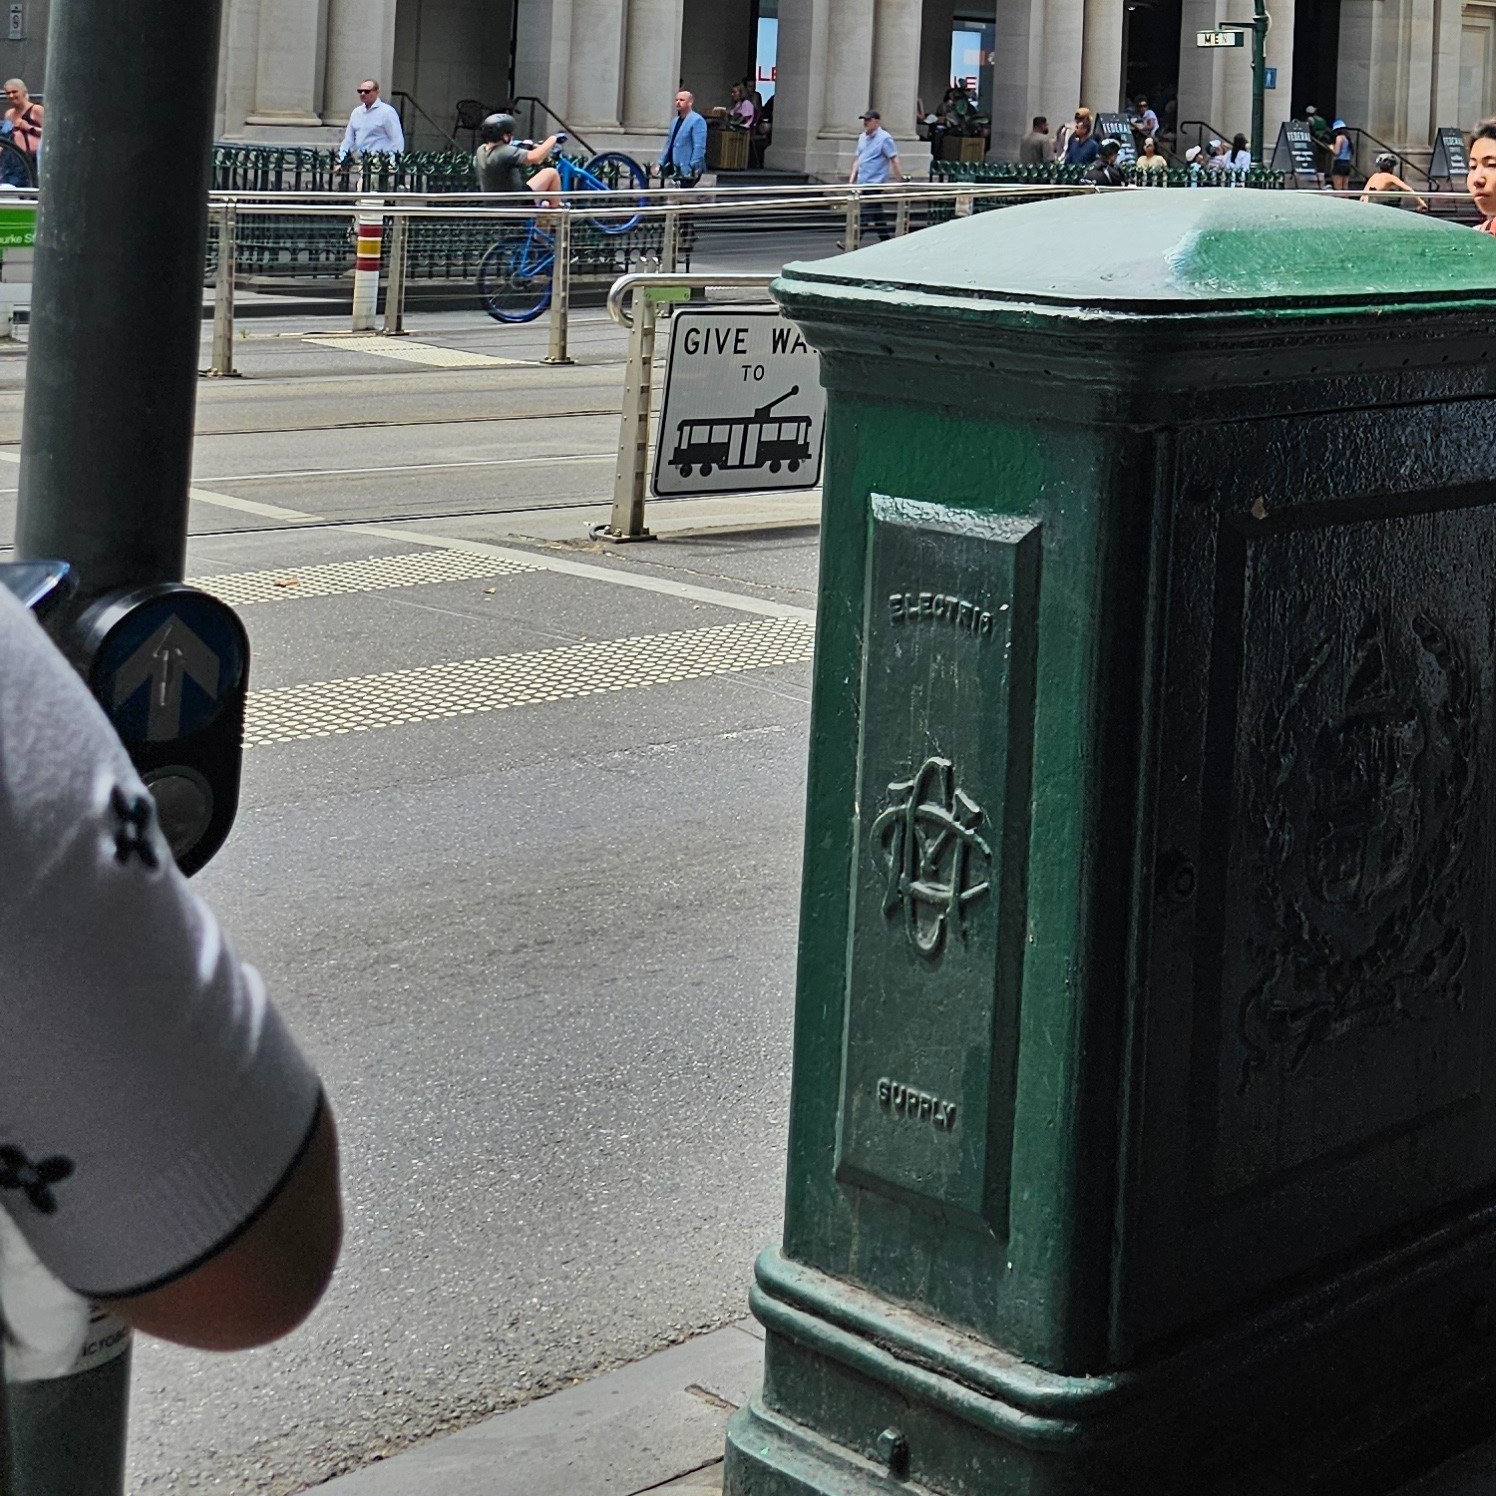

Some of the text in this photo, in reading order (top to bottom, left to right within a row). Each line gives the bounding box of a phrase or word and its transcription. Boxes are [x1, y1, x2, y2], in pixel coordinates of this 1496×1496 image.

[684, 327, 818, 355] GIVE WA
[741, 365, 765, 381] TO
[876, 1076, 957, 1130] SUPPLY
